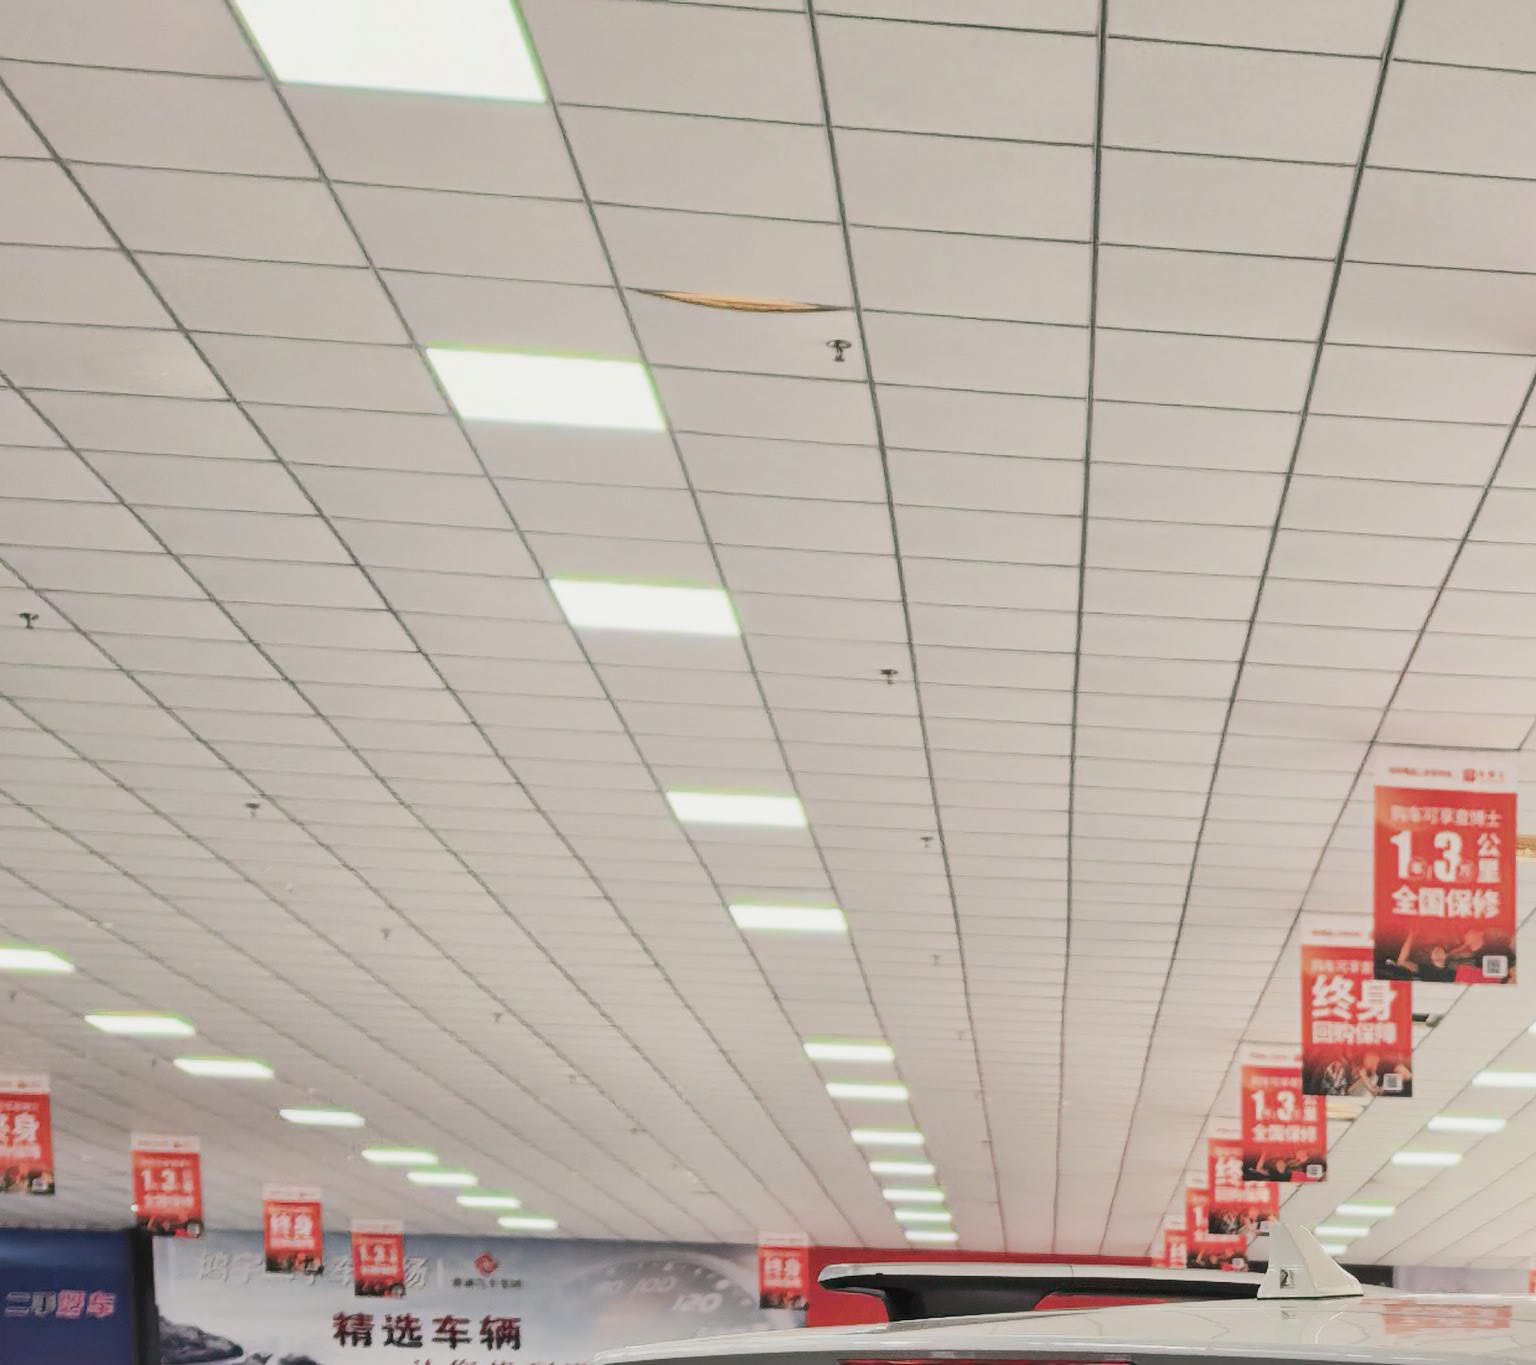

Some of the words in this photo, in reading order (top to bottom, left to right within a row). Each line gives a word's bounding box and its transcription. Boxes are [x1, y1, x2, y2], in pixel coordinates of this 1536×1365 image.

[1392, 885, 1501, 919] 全国保修
[1311, 973, 1398, 1023] 终身
[672, 1293, 723, 1313] 120
[333, 1311, 522, 1351] 精选车辆
